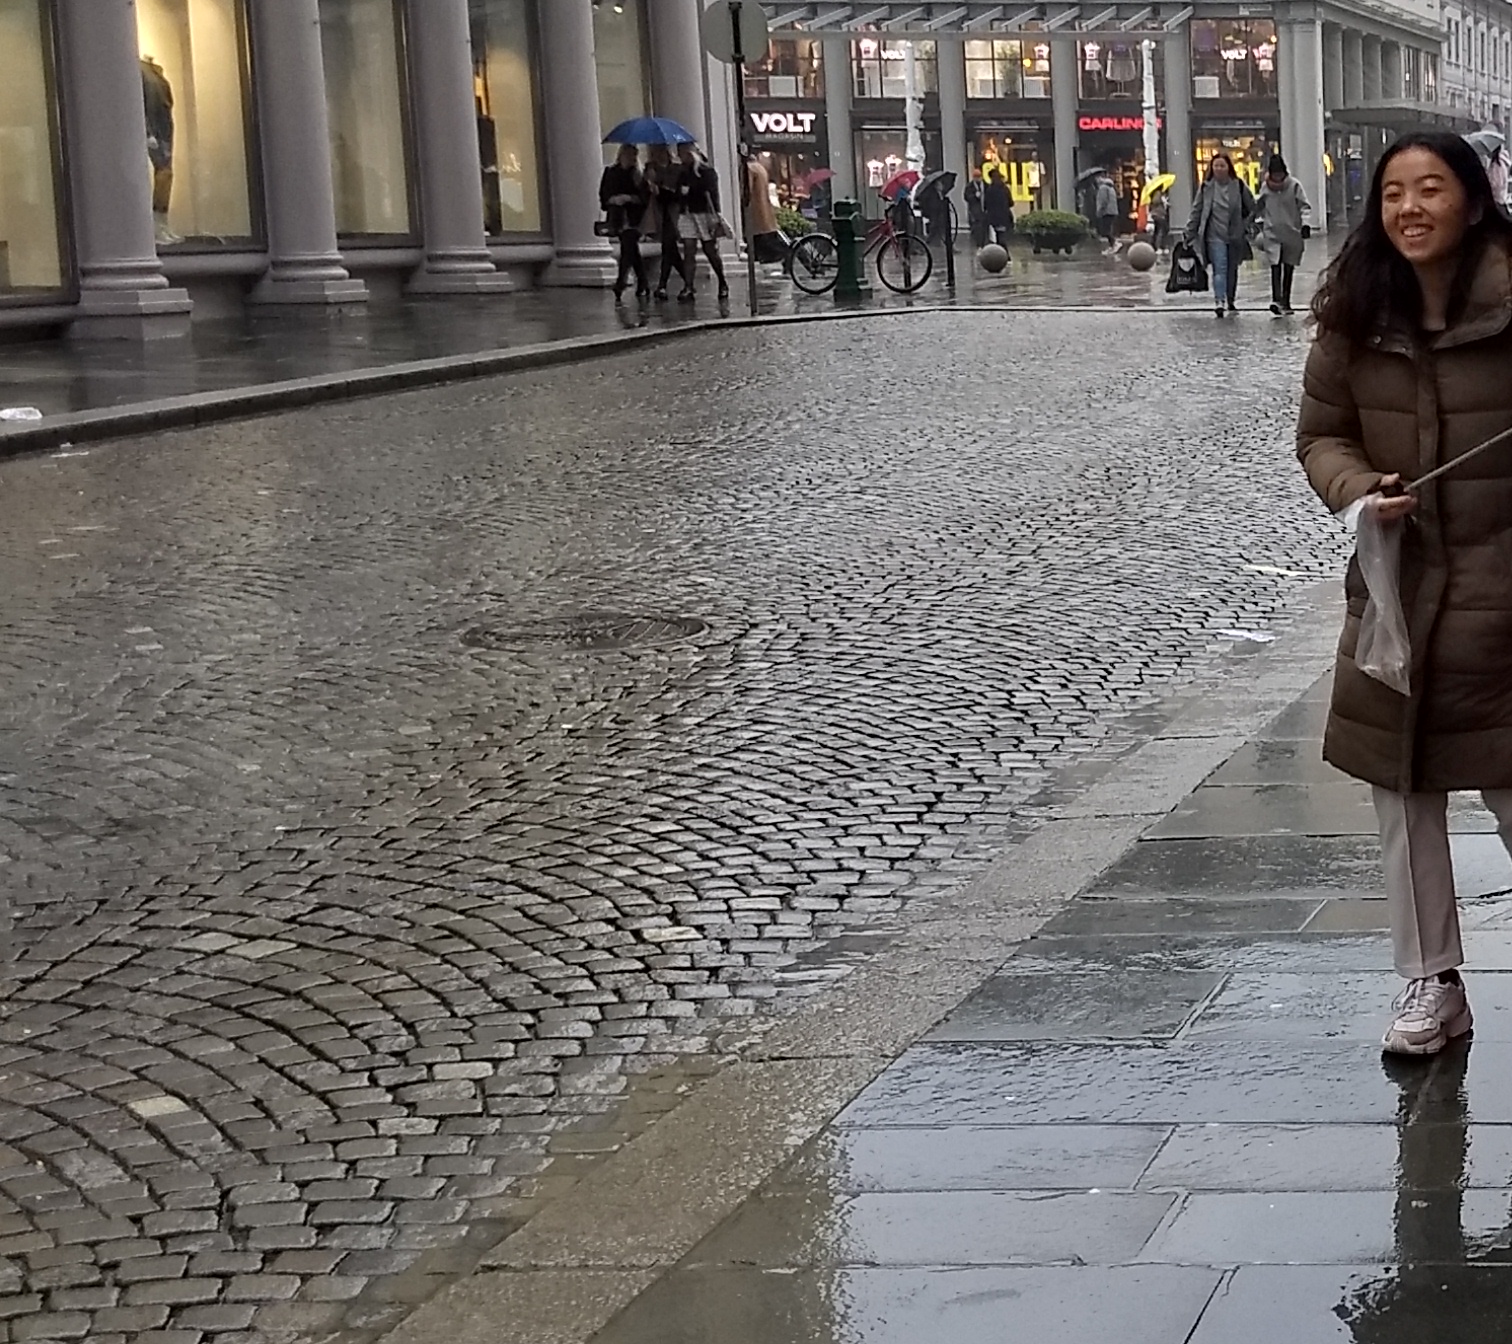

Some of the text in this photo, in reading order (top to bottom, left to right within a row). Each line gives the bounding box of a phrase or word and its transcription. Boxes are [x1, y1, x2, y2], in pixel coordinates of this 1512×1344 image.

[1220, 48, 1248, 60] VOLT
[750, 112, 816, 134] VOLT
[1079, 116, 1162, 130] CARLINS
